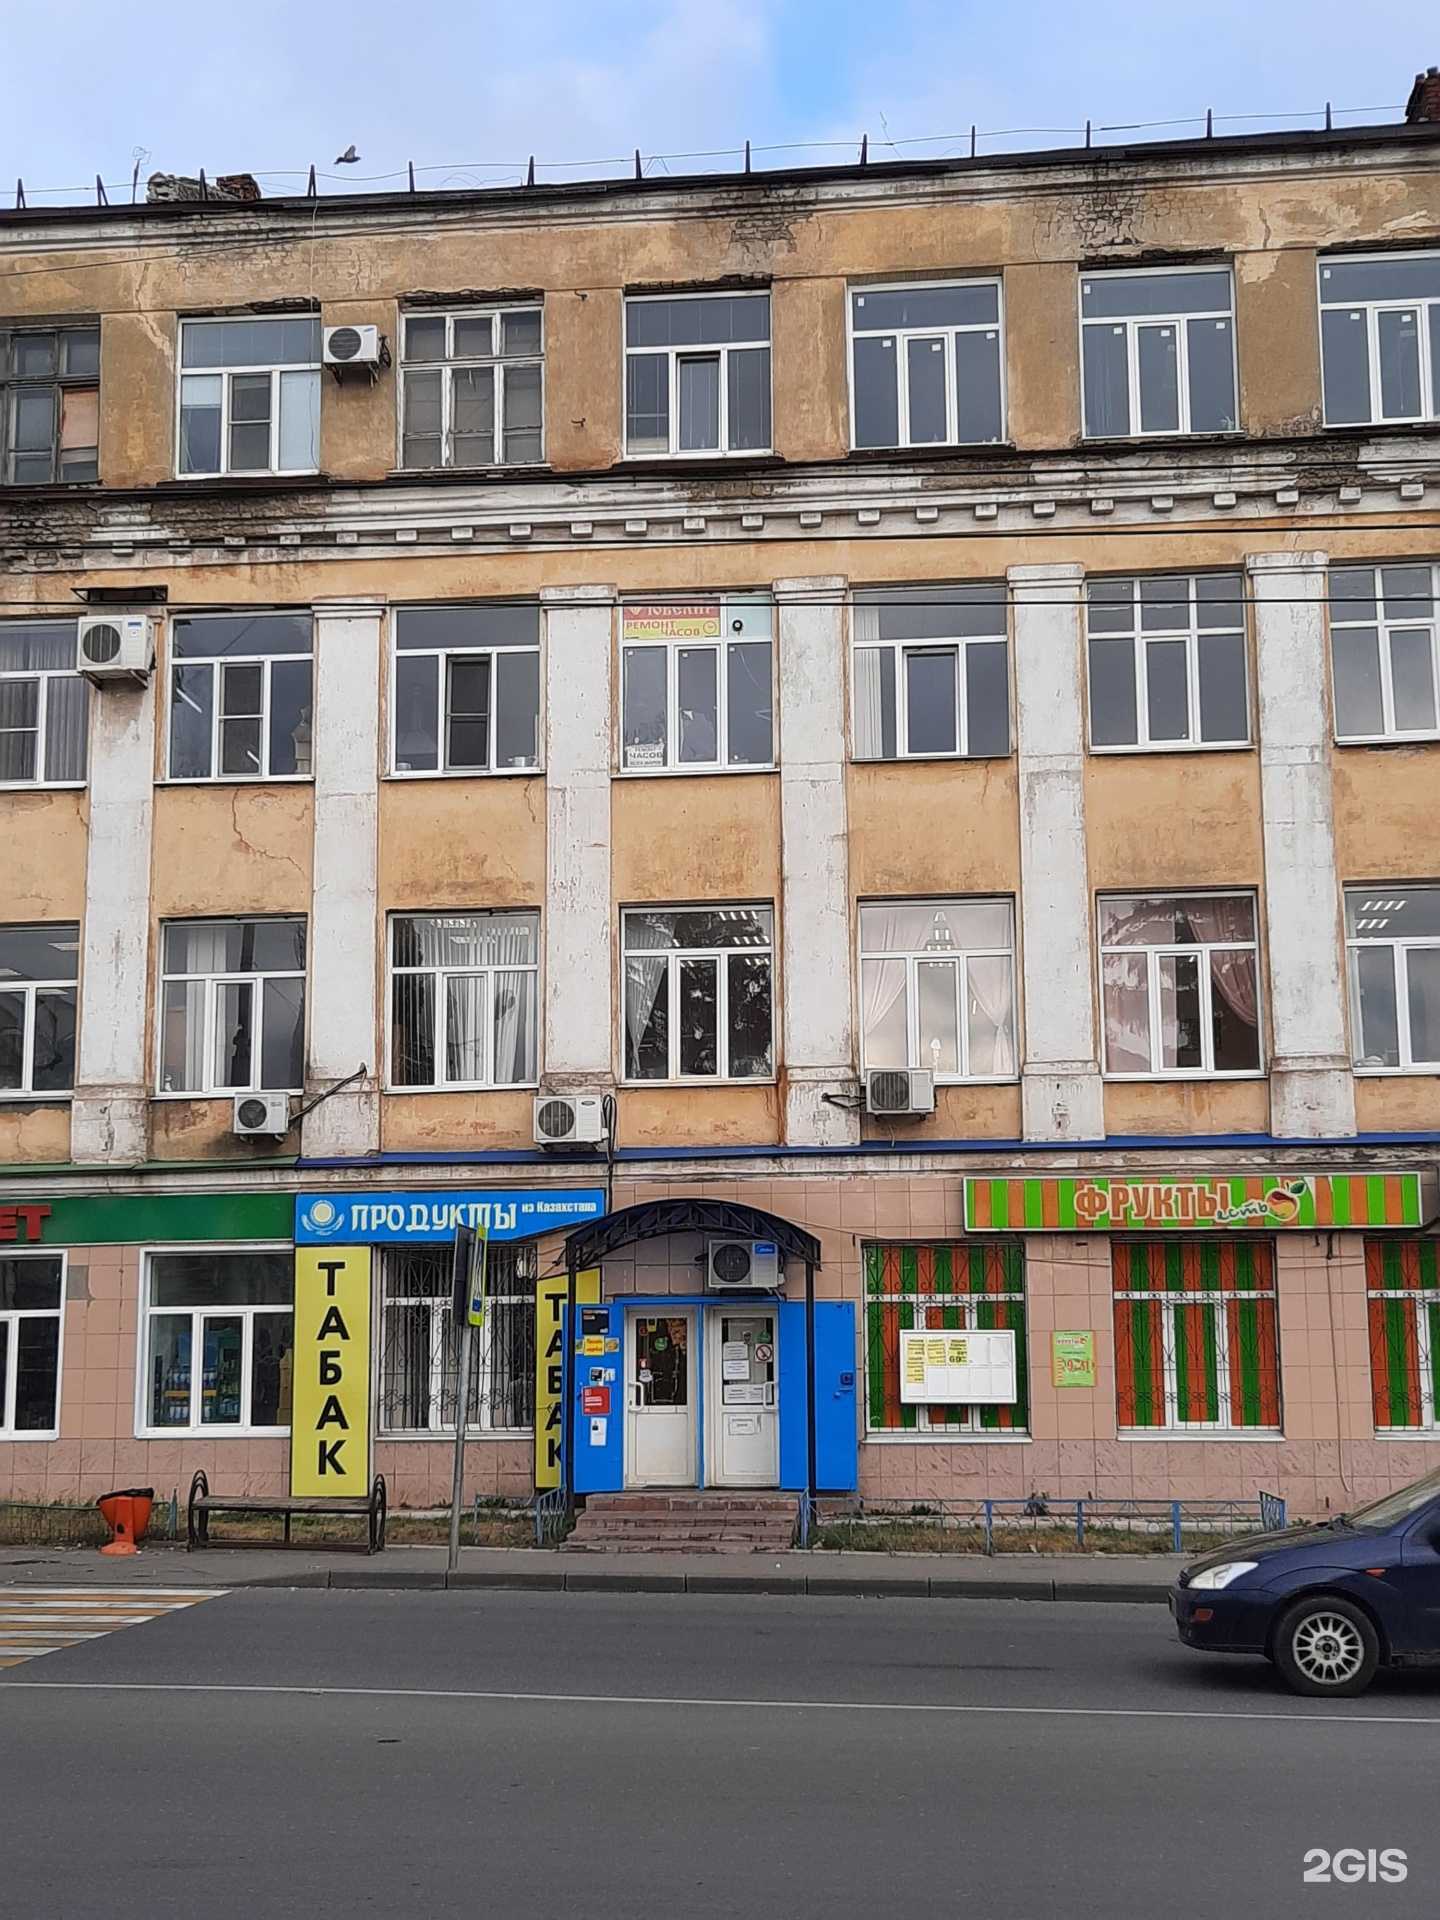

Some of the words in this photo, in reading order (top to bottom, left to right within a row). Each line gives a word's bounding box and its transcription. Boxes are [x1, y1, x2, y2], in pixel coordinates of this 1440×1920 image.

[626, 620, 676, 630] РЕМОНТ
[661, 627, 701, 637] ЧАСОВ
[351, 1201, 517, 1233] ПРОДУКТЫ
[522, 1203, 535, 1212] из
[536, 1201, 597, 1213] Казахстана
[1074, 1182, 1230, 1221] ФРУКТЫ
[316, 1260, 350, 1475] ТАБАК
